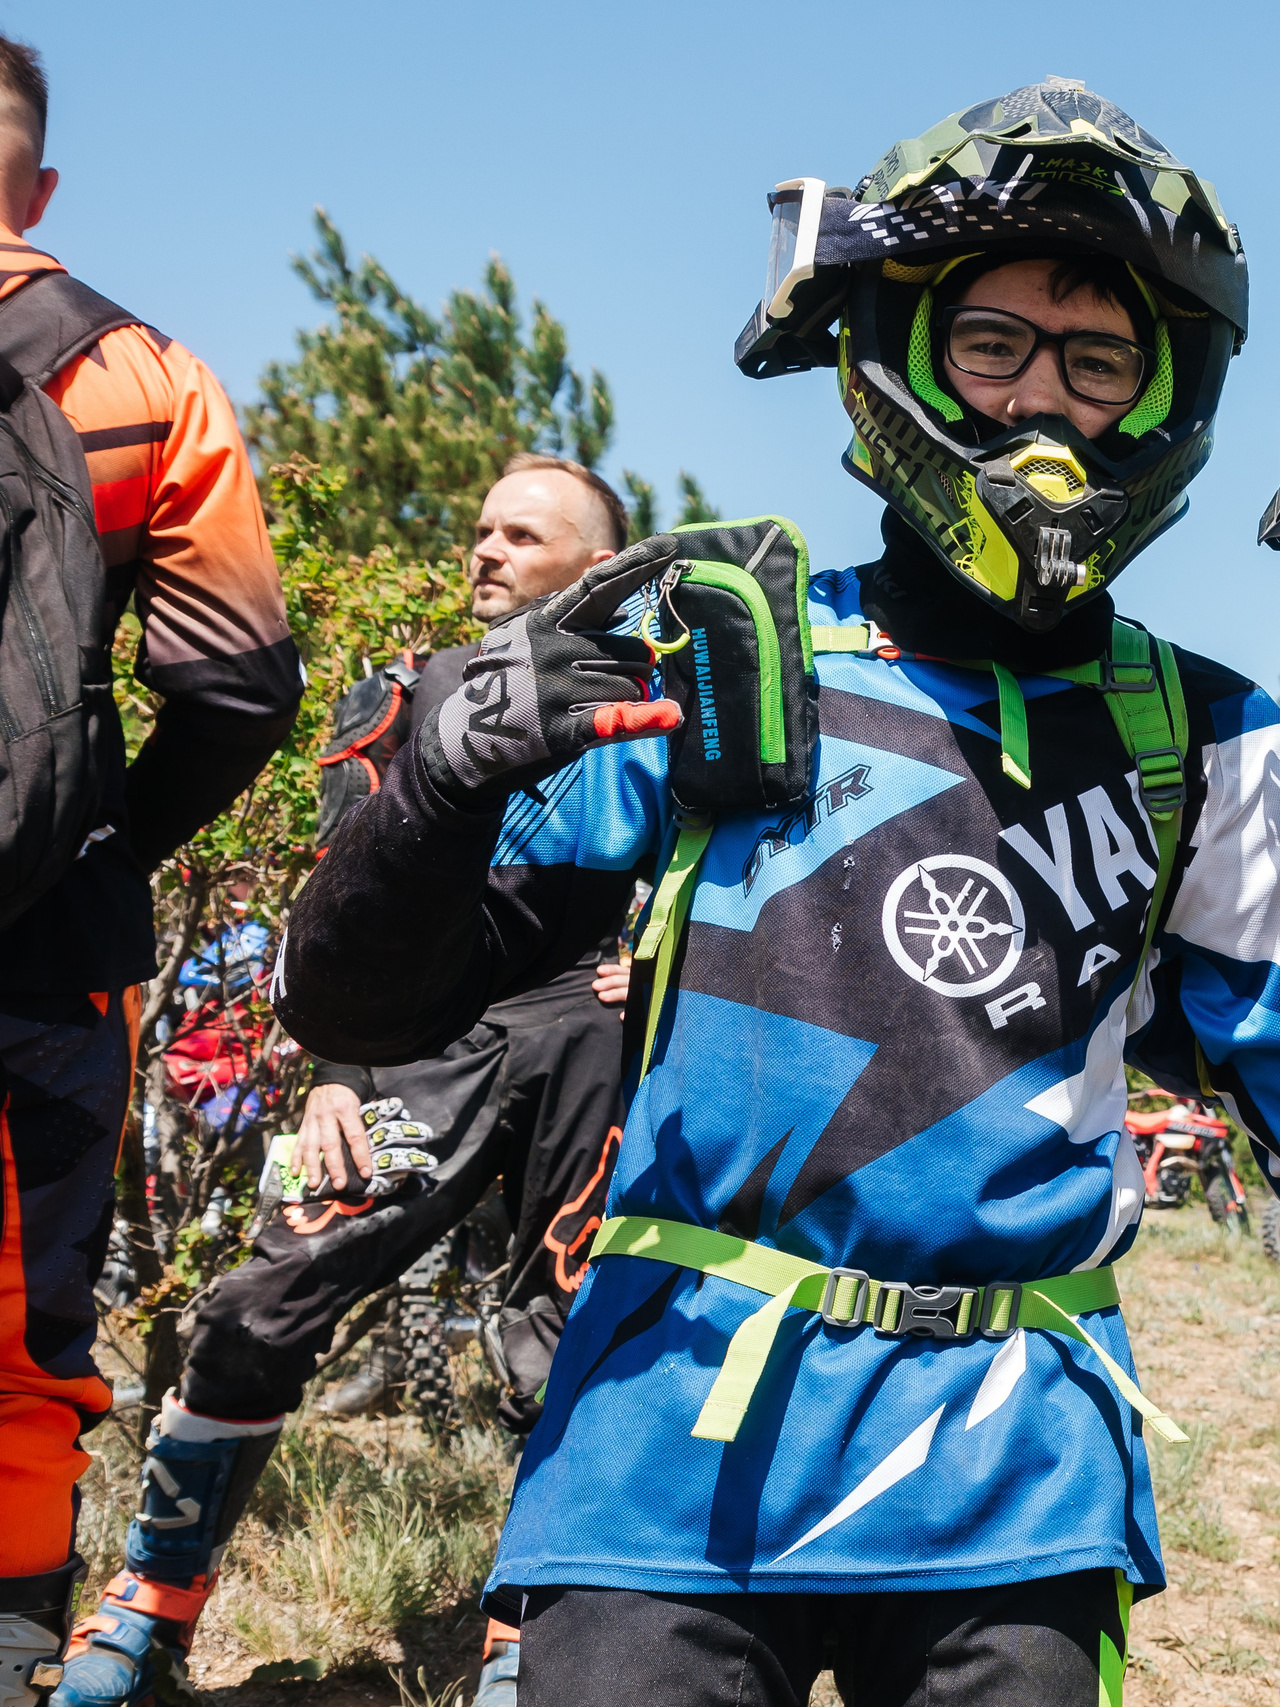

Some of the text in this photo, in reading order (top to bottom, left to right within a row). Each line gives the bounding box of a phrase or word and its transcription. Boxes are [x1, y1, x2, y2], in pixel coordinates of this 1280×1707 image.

[1044, 157, 1106, 180] MASK
[1131, 457, 1206, 526] JUST
[692, 627, 722, 761] HUWAIJIANFENG
